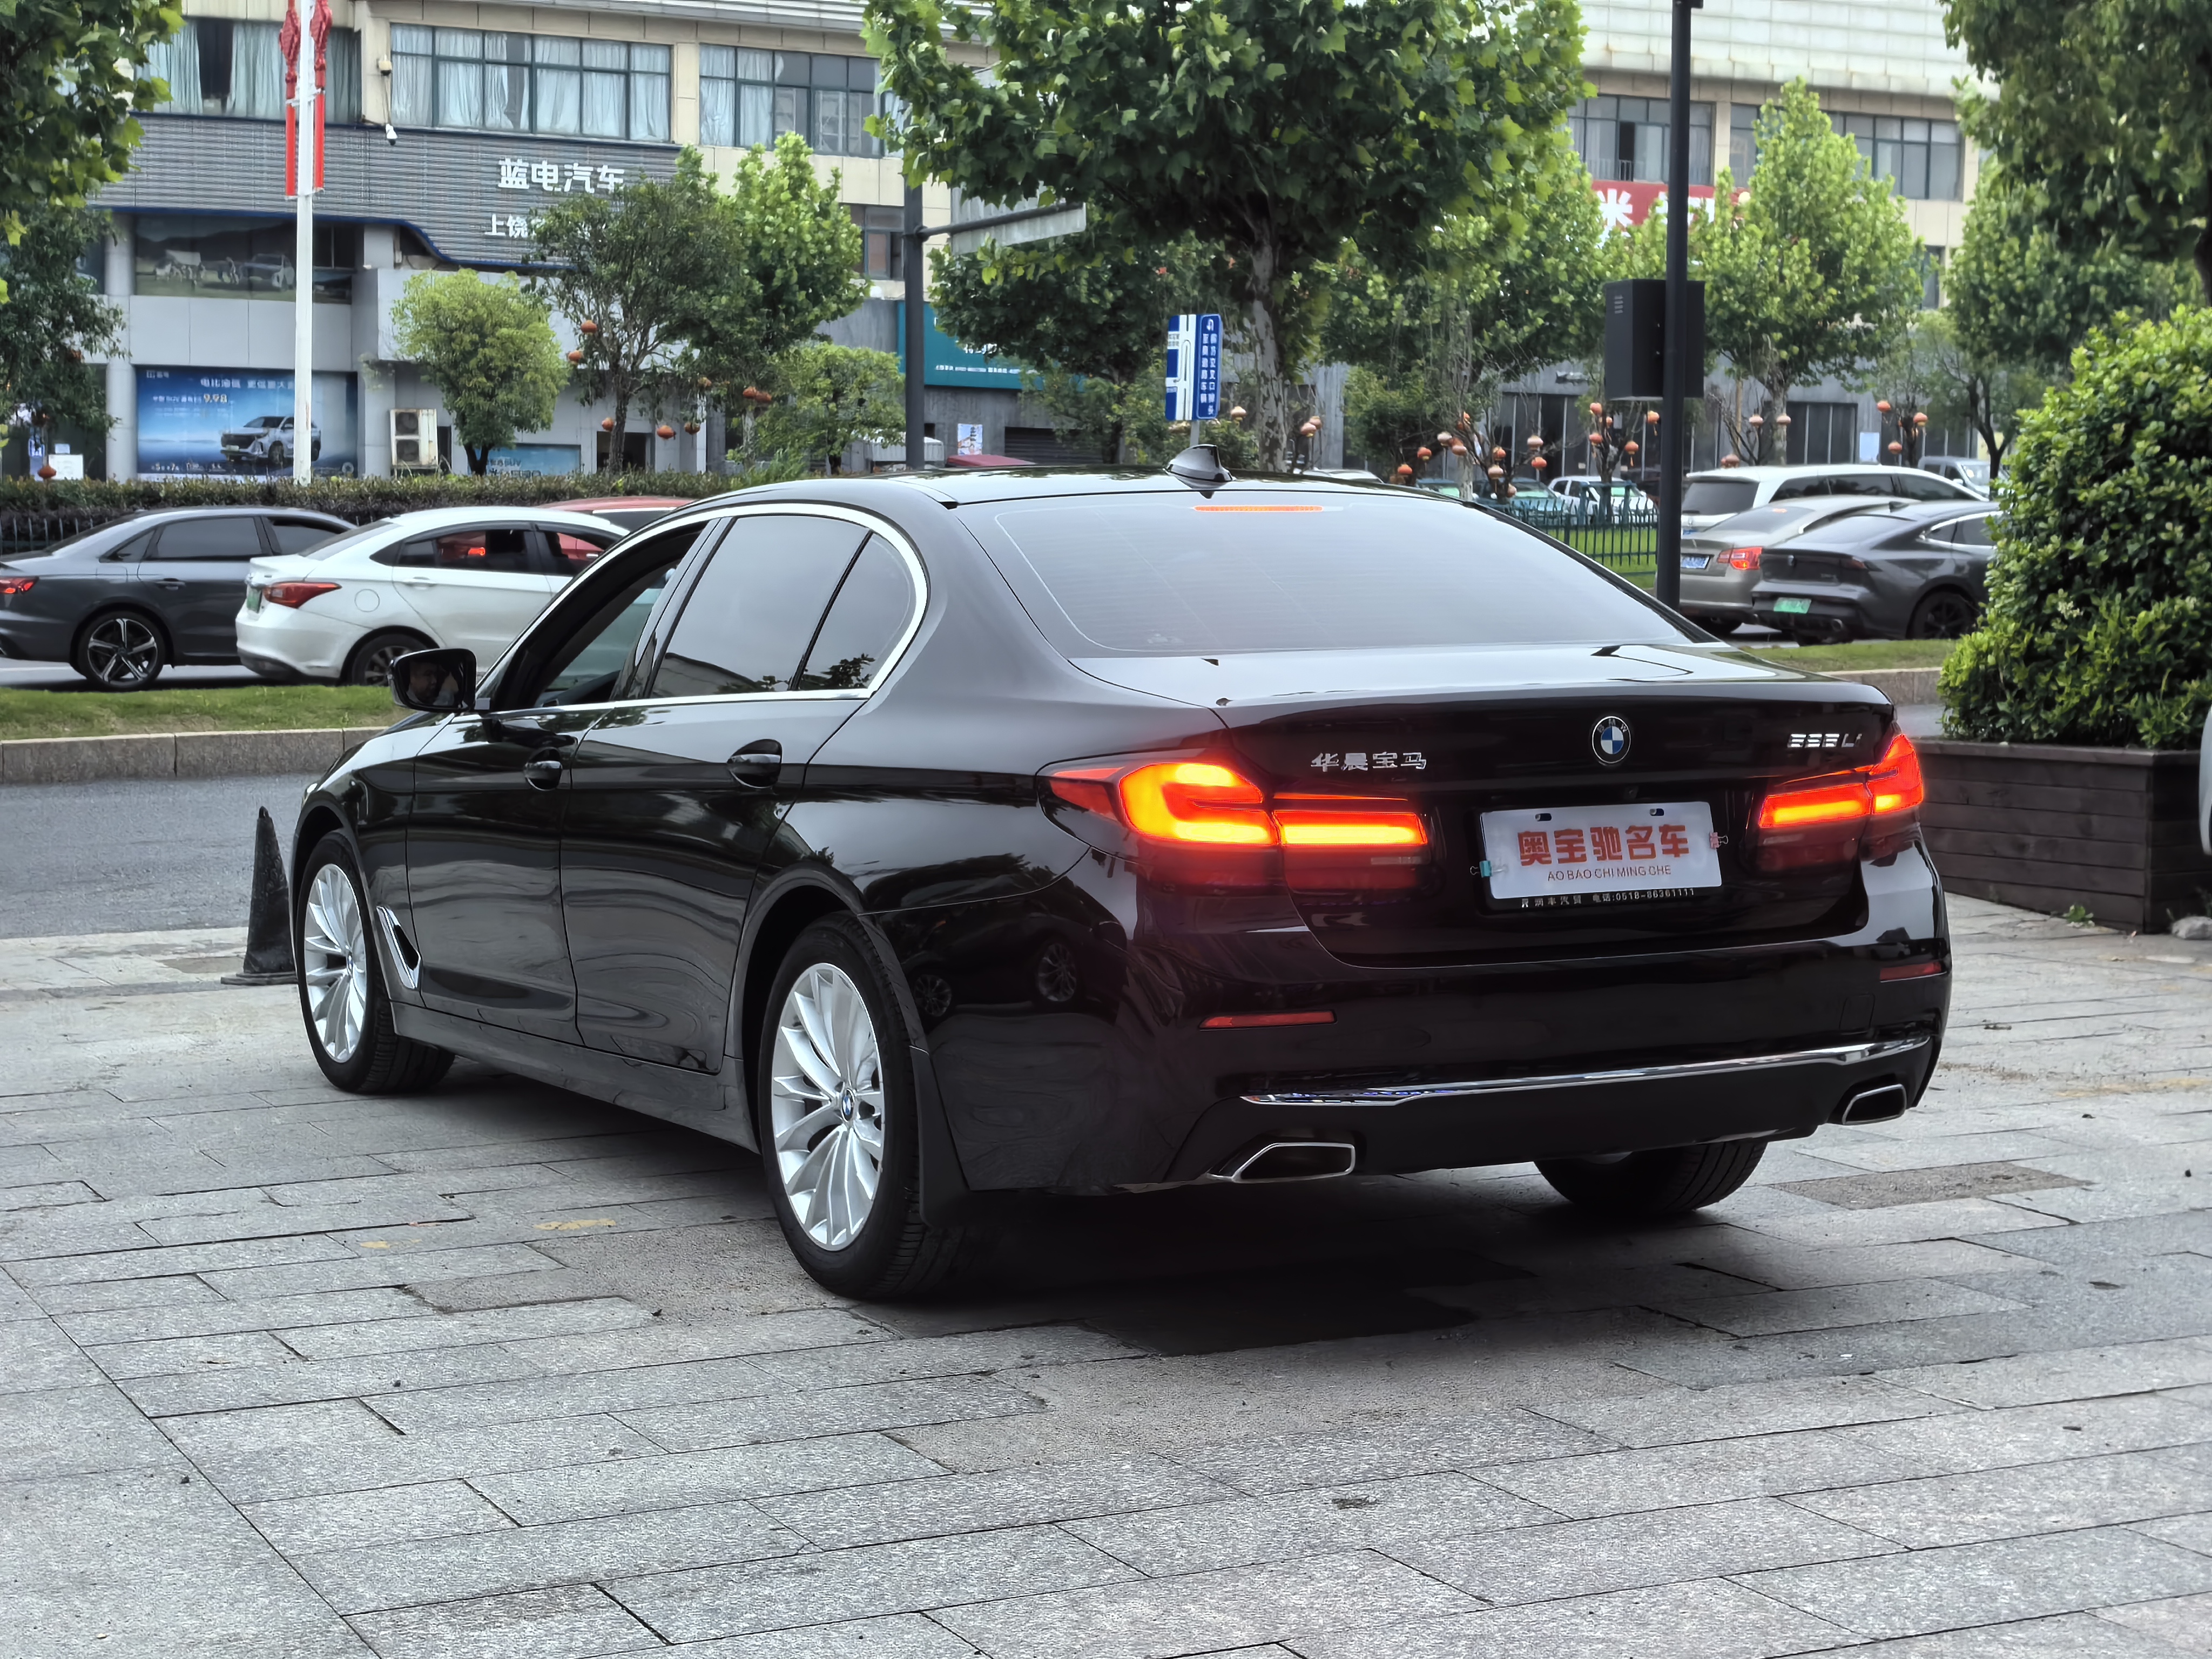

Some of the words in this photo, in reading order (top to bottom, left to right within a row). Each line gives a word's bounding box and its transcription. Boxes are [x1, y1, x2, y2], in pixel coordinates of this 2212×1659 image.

[498, 158, 625, 194] 蓝电汽车
[1597, 718, 1628, 733] BMW
[1311, 752, 1427, 772] 华晨宝马
[1518, 824, 1689, 866] 奥宝驰名车
[1548, 871, 1564, 881] AO
[1567, 869, 1591, 880] BAO
[1595, 867, 1614, 879] CHI
[1617, 866, 1647, 877] MING
